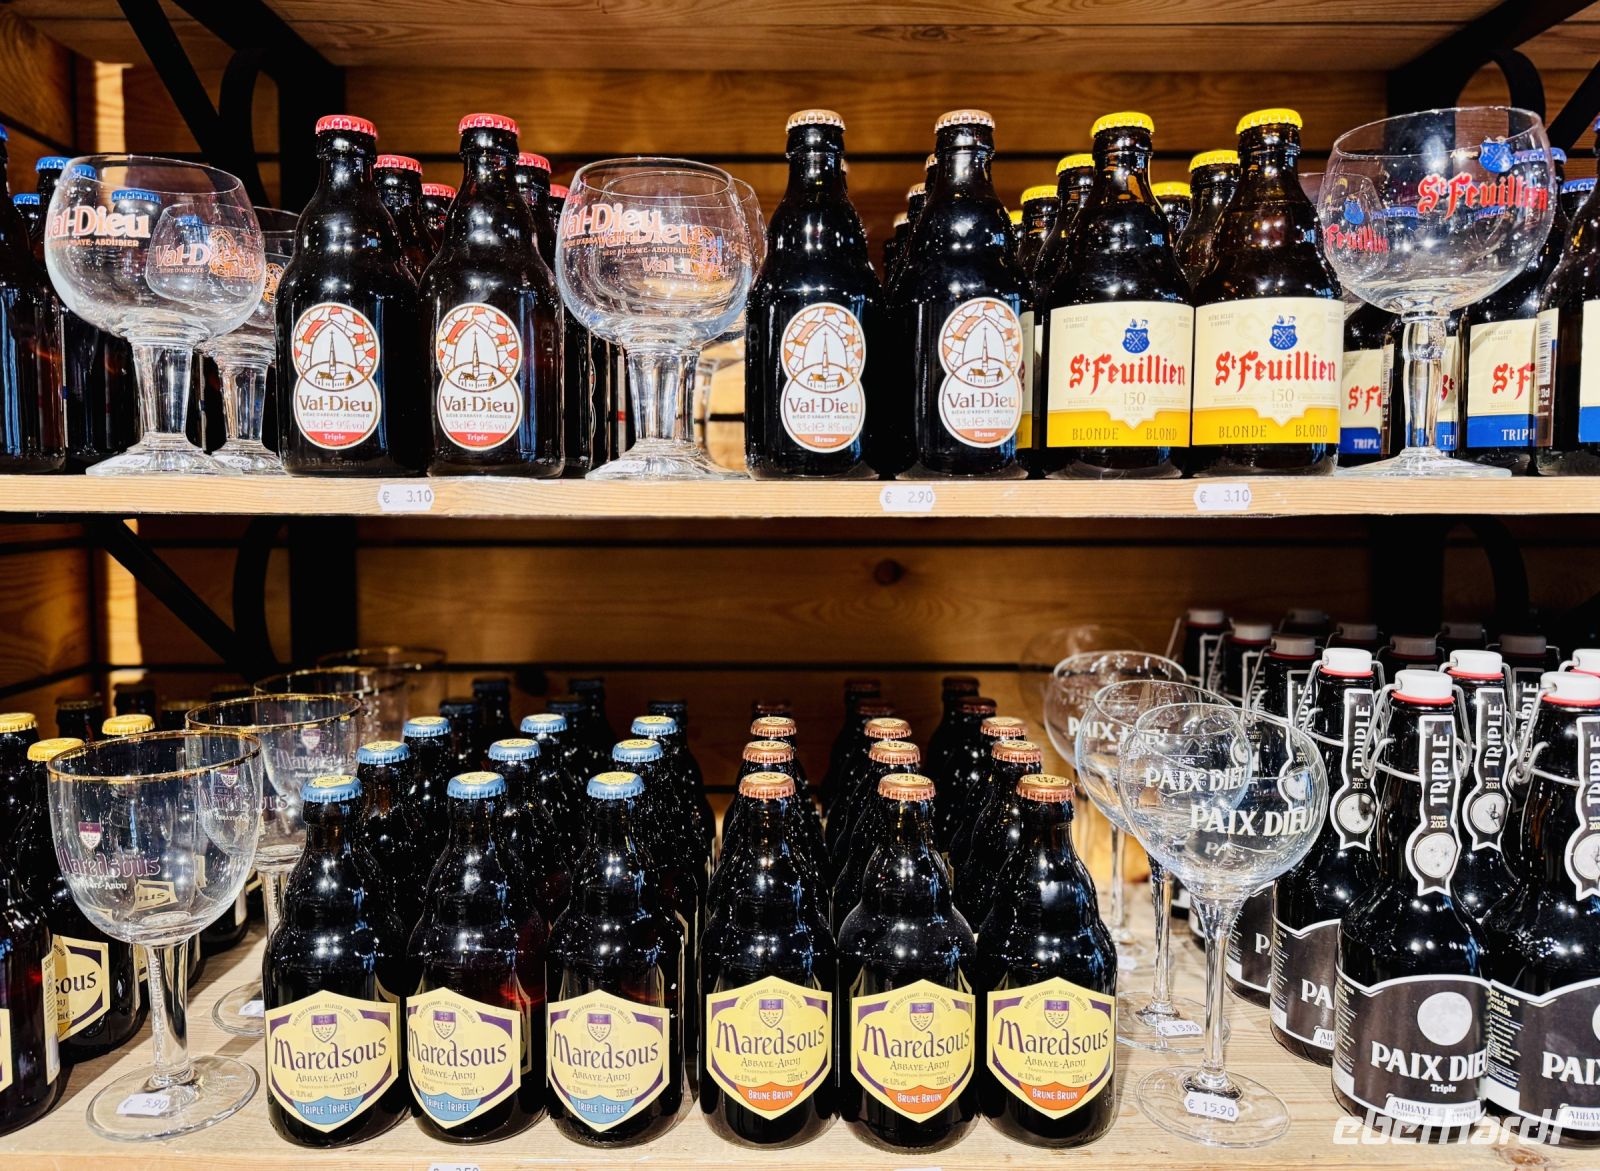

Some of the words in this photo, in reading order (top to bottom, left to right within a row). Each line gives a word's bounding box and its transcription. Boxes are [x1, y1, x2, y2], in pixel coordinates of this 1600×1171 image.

[46, 205, 151, 239] Val-Dieu
[561, 202, 662, 240] Val-Dieu
[1090, 353, 1186, 395] Feuillien
[1238, 350, 1336, 393] Feuillien
[299, 395, 373, 412] Val-Dieu
[442, 395, 514, 413] Val-Dieu
[788, 397, 859, 414] Val-Dieu
[947, 392, 1017, 409] Val-Dieu
[1072, 427, 1120, 441] BLONDE
[1146, 427, 1178, 441] BLOND
[1218, 424, 1267, 438] BLONDE
[1295, 423, 1328, 438] BLOND
[383, 491, 390, 504] €
[406, 489, 432, 503] 3.10
[885, 491, 892, 504] €
[908, 491, 934, 504] 2.90
[1200, 490, 1207, 503] €
[1224, 489, 1250, 503] 3.10
[1483, 704, 1503, 769] TRIPLE
[1429, 733, 1451, 807] TRIPLE
[1144, 767, 1205, 792] PAIX
[1209, 767, 1247, 792] DIEU
[1190, 804, 1257, 836] PAIX
[1263, 807, 1314, 837] DIEU
[1430, 820, 1448, 829] 2025
[1301, 978, 1334, 1010] PA
[997, 1017, 1108, 1056] Maredsous
[1171, 1023, 1200, 1033] 15.90
[715, 1019, 825, 1056] Maredsous
[862, 1023, 970, 1059] Maredsous
[274, 1036, 387, 1072] Maredsous
[408, 1027, 507, 1068] Maredsous
[553, 1030, 659, 1070] Maredsous
[1370, 1041, 1444, 1082] PAIX
[748, 1090, 771, 1100] BRUNE
[772, 1089, 793, 1100] BRUIN
[897, 1092, 920, 1103] BRUNE
[921, 1092, 942, 1103] BRUIN
[1032, 1088, 1055, 1099] BRUNE
[1057, 1089, 1078, 1099] BRUIN
[1430, 1083, 1457, 1094] Triple
[301, 1103, 325, 1115] TRIPLE
[328, 1102, 353, 1114] TRIPEL
[425, 1096, 444, 1110] TRIPLE
[447, 1099, 471, 1112] TRIPEL
[577, 1100, 598, 1112] TRIPLE
[601, 1103, 626, 1114] TRIPEL
[1187, 1099, 1195, 1109] €
[1203, 1101, 1235, 1118] 15.90
